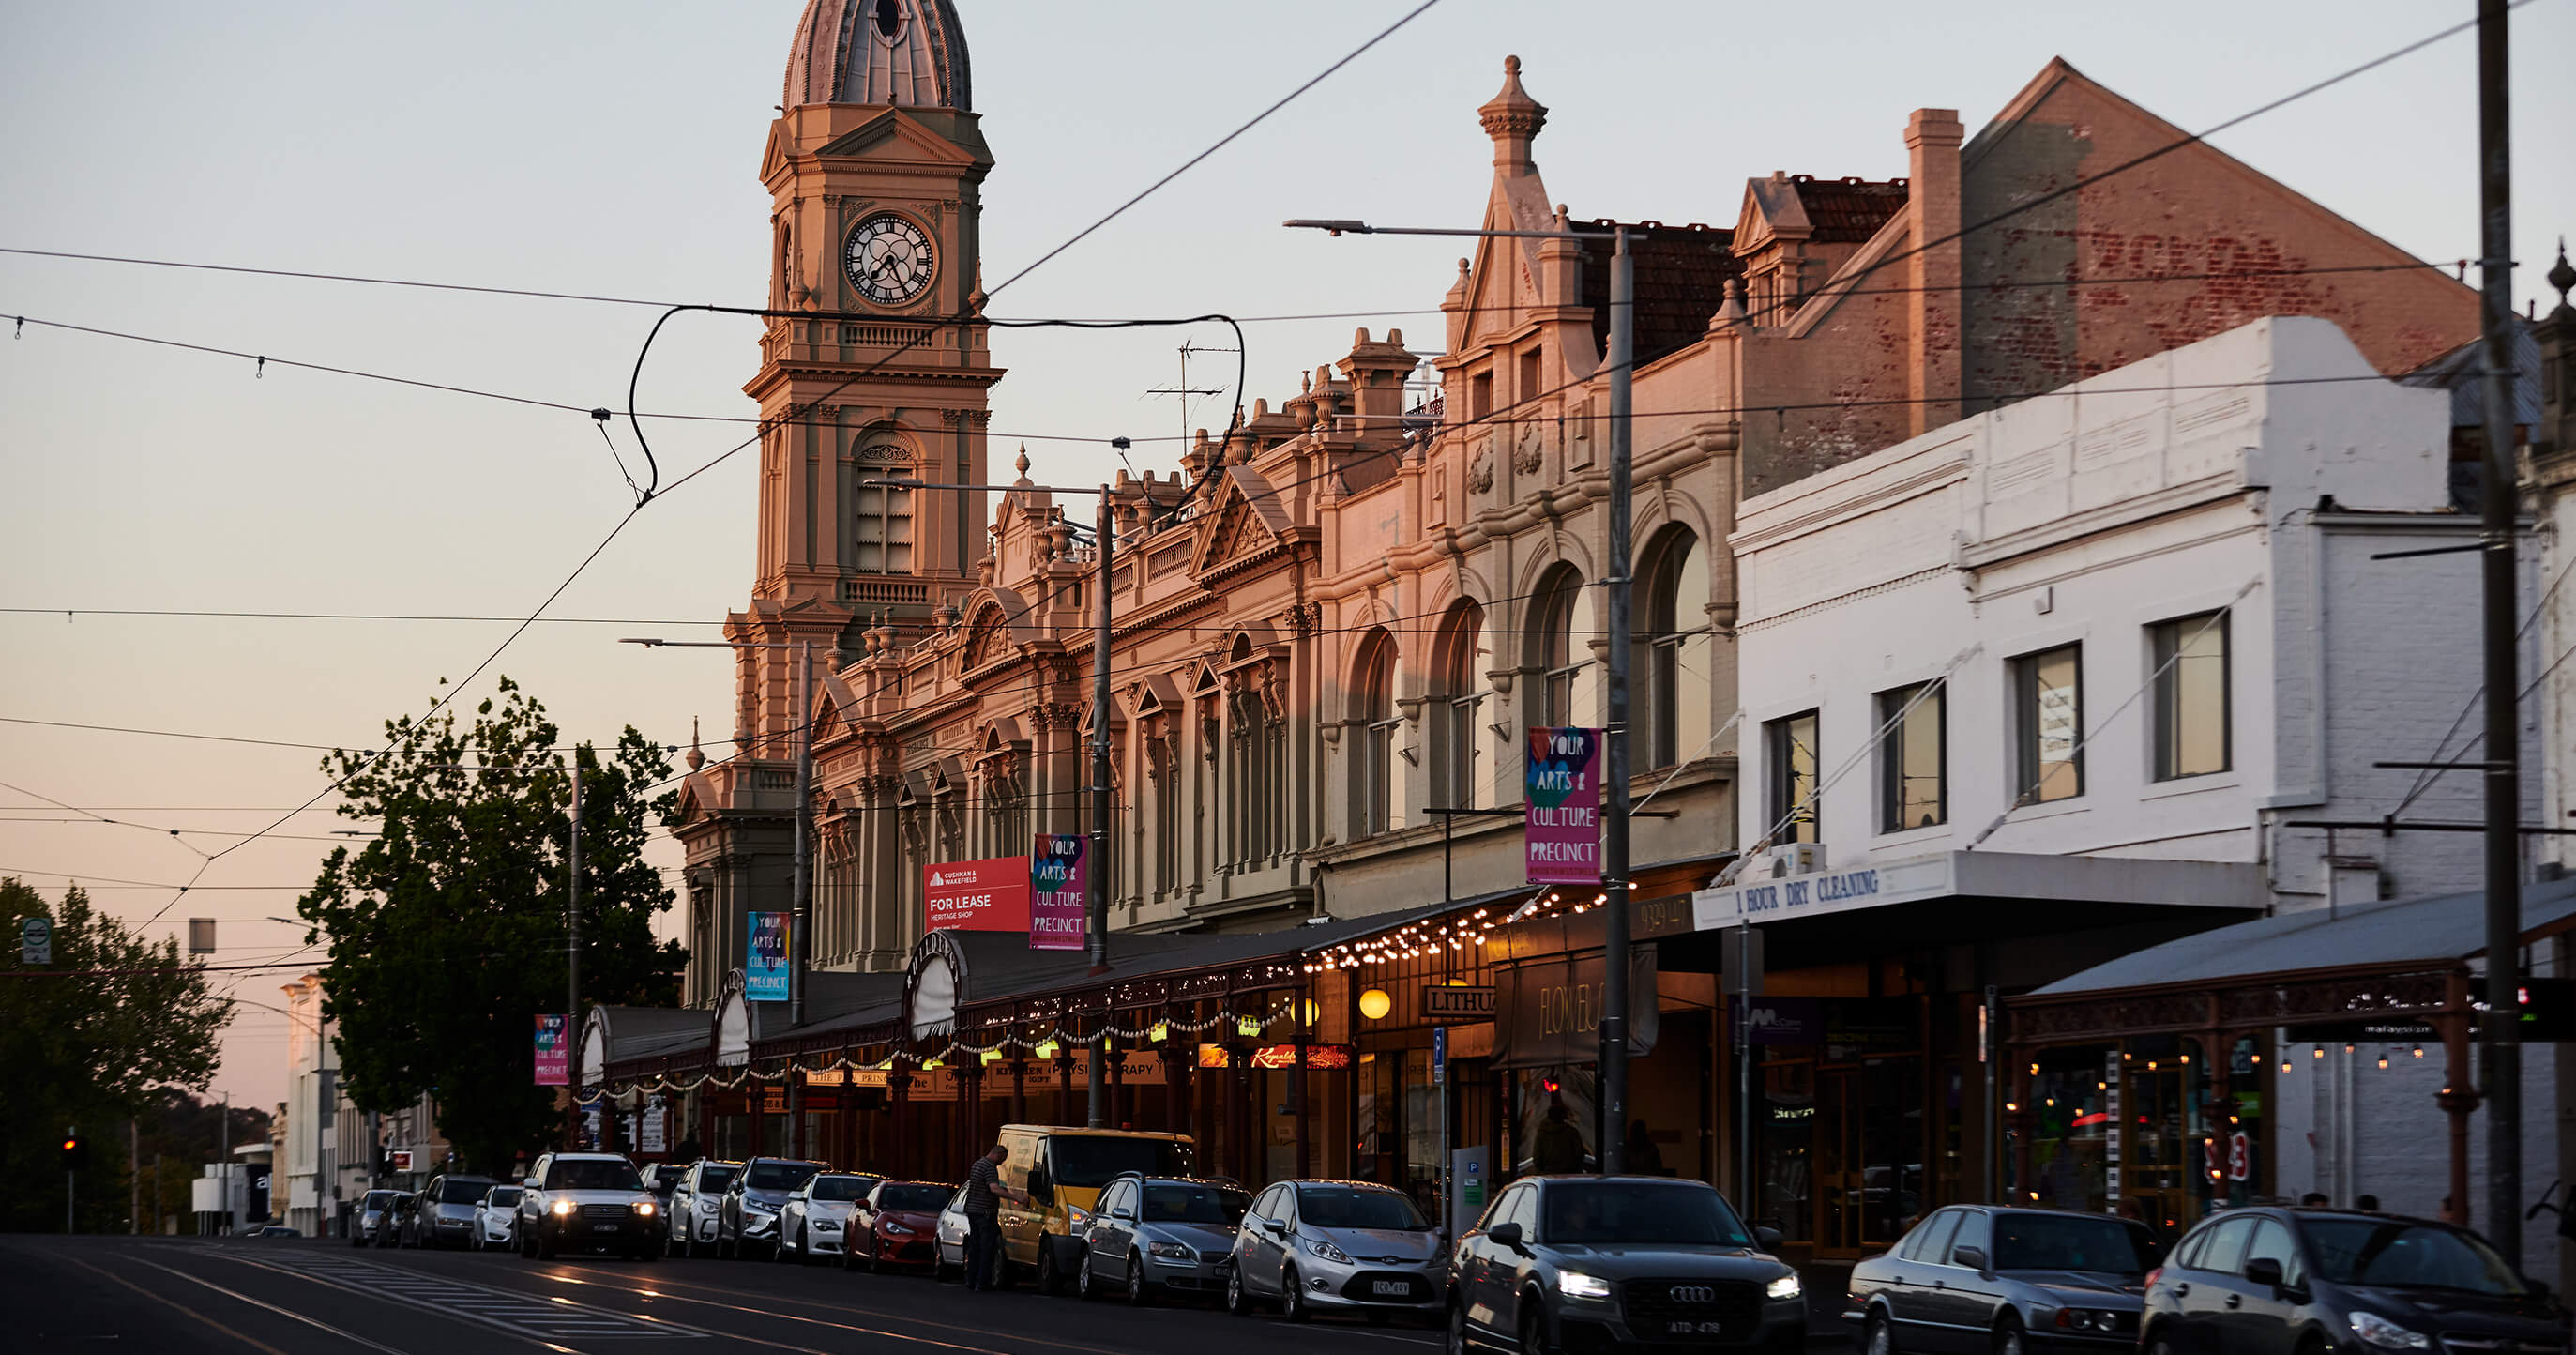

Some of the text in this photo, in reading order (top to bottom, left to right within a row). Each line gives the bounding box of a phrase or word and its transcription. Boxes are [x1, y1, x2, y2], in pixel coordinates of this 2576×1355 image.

[1548, 735, 1584, 755] YOUR
[1537, 769, 1585, 791] ARTS &
[1532, 806, 1594, 828] CULTURE
[1049, 841, 1075, 855] YOUR
[1530, 842, 1596, 862] PRECINCT
[944, 871, 972, 879] CUSHMAN
[1040, 865, 1076, 881] ARTS &
[945, 876, 977, 885] WAKEFIELD
[1735, 869, 1879, 914] 1 HOUR DRY CLEANING
[931, 894, 992, 912] FOR LEASE
[1037, 891, 1082, 907] CULTURE
[758, 916, 781, 928] YOUR
[931, 910, 973, 921] HERITAGE SHOP
[1034, 917, 1082, 933] PRECINCT
[752, 936, 773, 949] ARTS
[750, 956, 787, 969] CULTURE
[749, 976, 787, 988] PRECINCT
[2364, 1025, 2432, 1035] malaysian
[537, 1049, 568, 1059] CULTURE
[537, 1066, 567, 1074] PRECINCT
[1471, 1163, 1477, 1171] P
